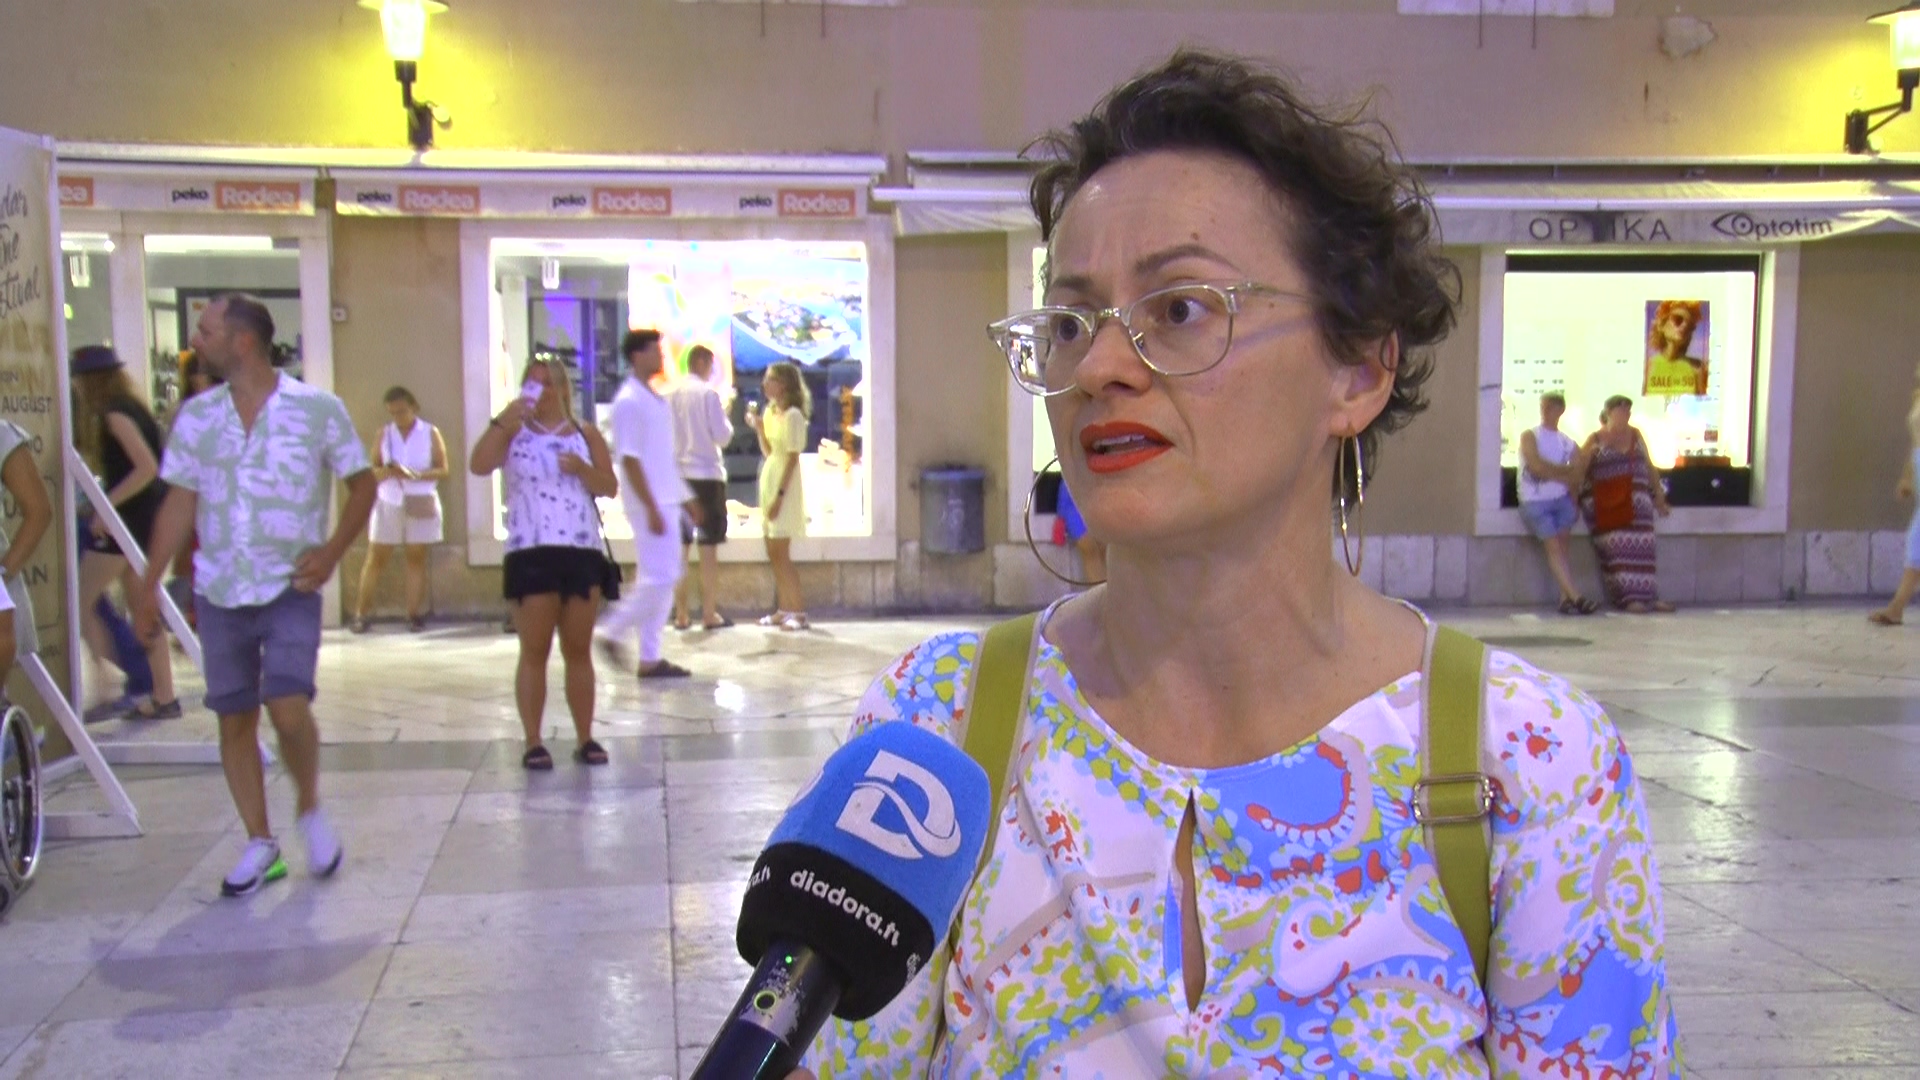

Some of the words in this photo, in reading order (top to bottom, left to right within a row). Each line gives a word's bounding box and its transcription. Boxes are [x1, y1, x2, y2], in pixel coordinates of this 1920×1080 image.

[171, 187, 209, 203] peko
[221, 184, 296, 209] Rodea
[356, 189, 392, 205] peko
[404, 188, 474, 211] Rodea
[552, 193, 587, 209] peko
[598, 190, 668, 213] Rodea
[739, 195, 773, 210] peko
[782, 192, 850, 213] Rodea
[1528, 217, 1672, 241] OPIKA
[1730, 212, 1833, 241] Optotim
[1650, 375, 1672, 388] SALE
[2, 395, 52, 414] AUGUST
